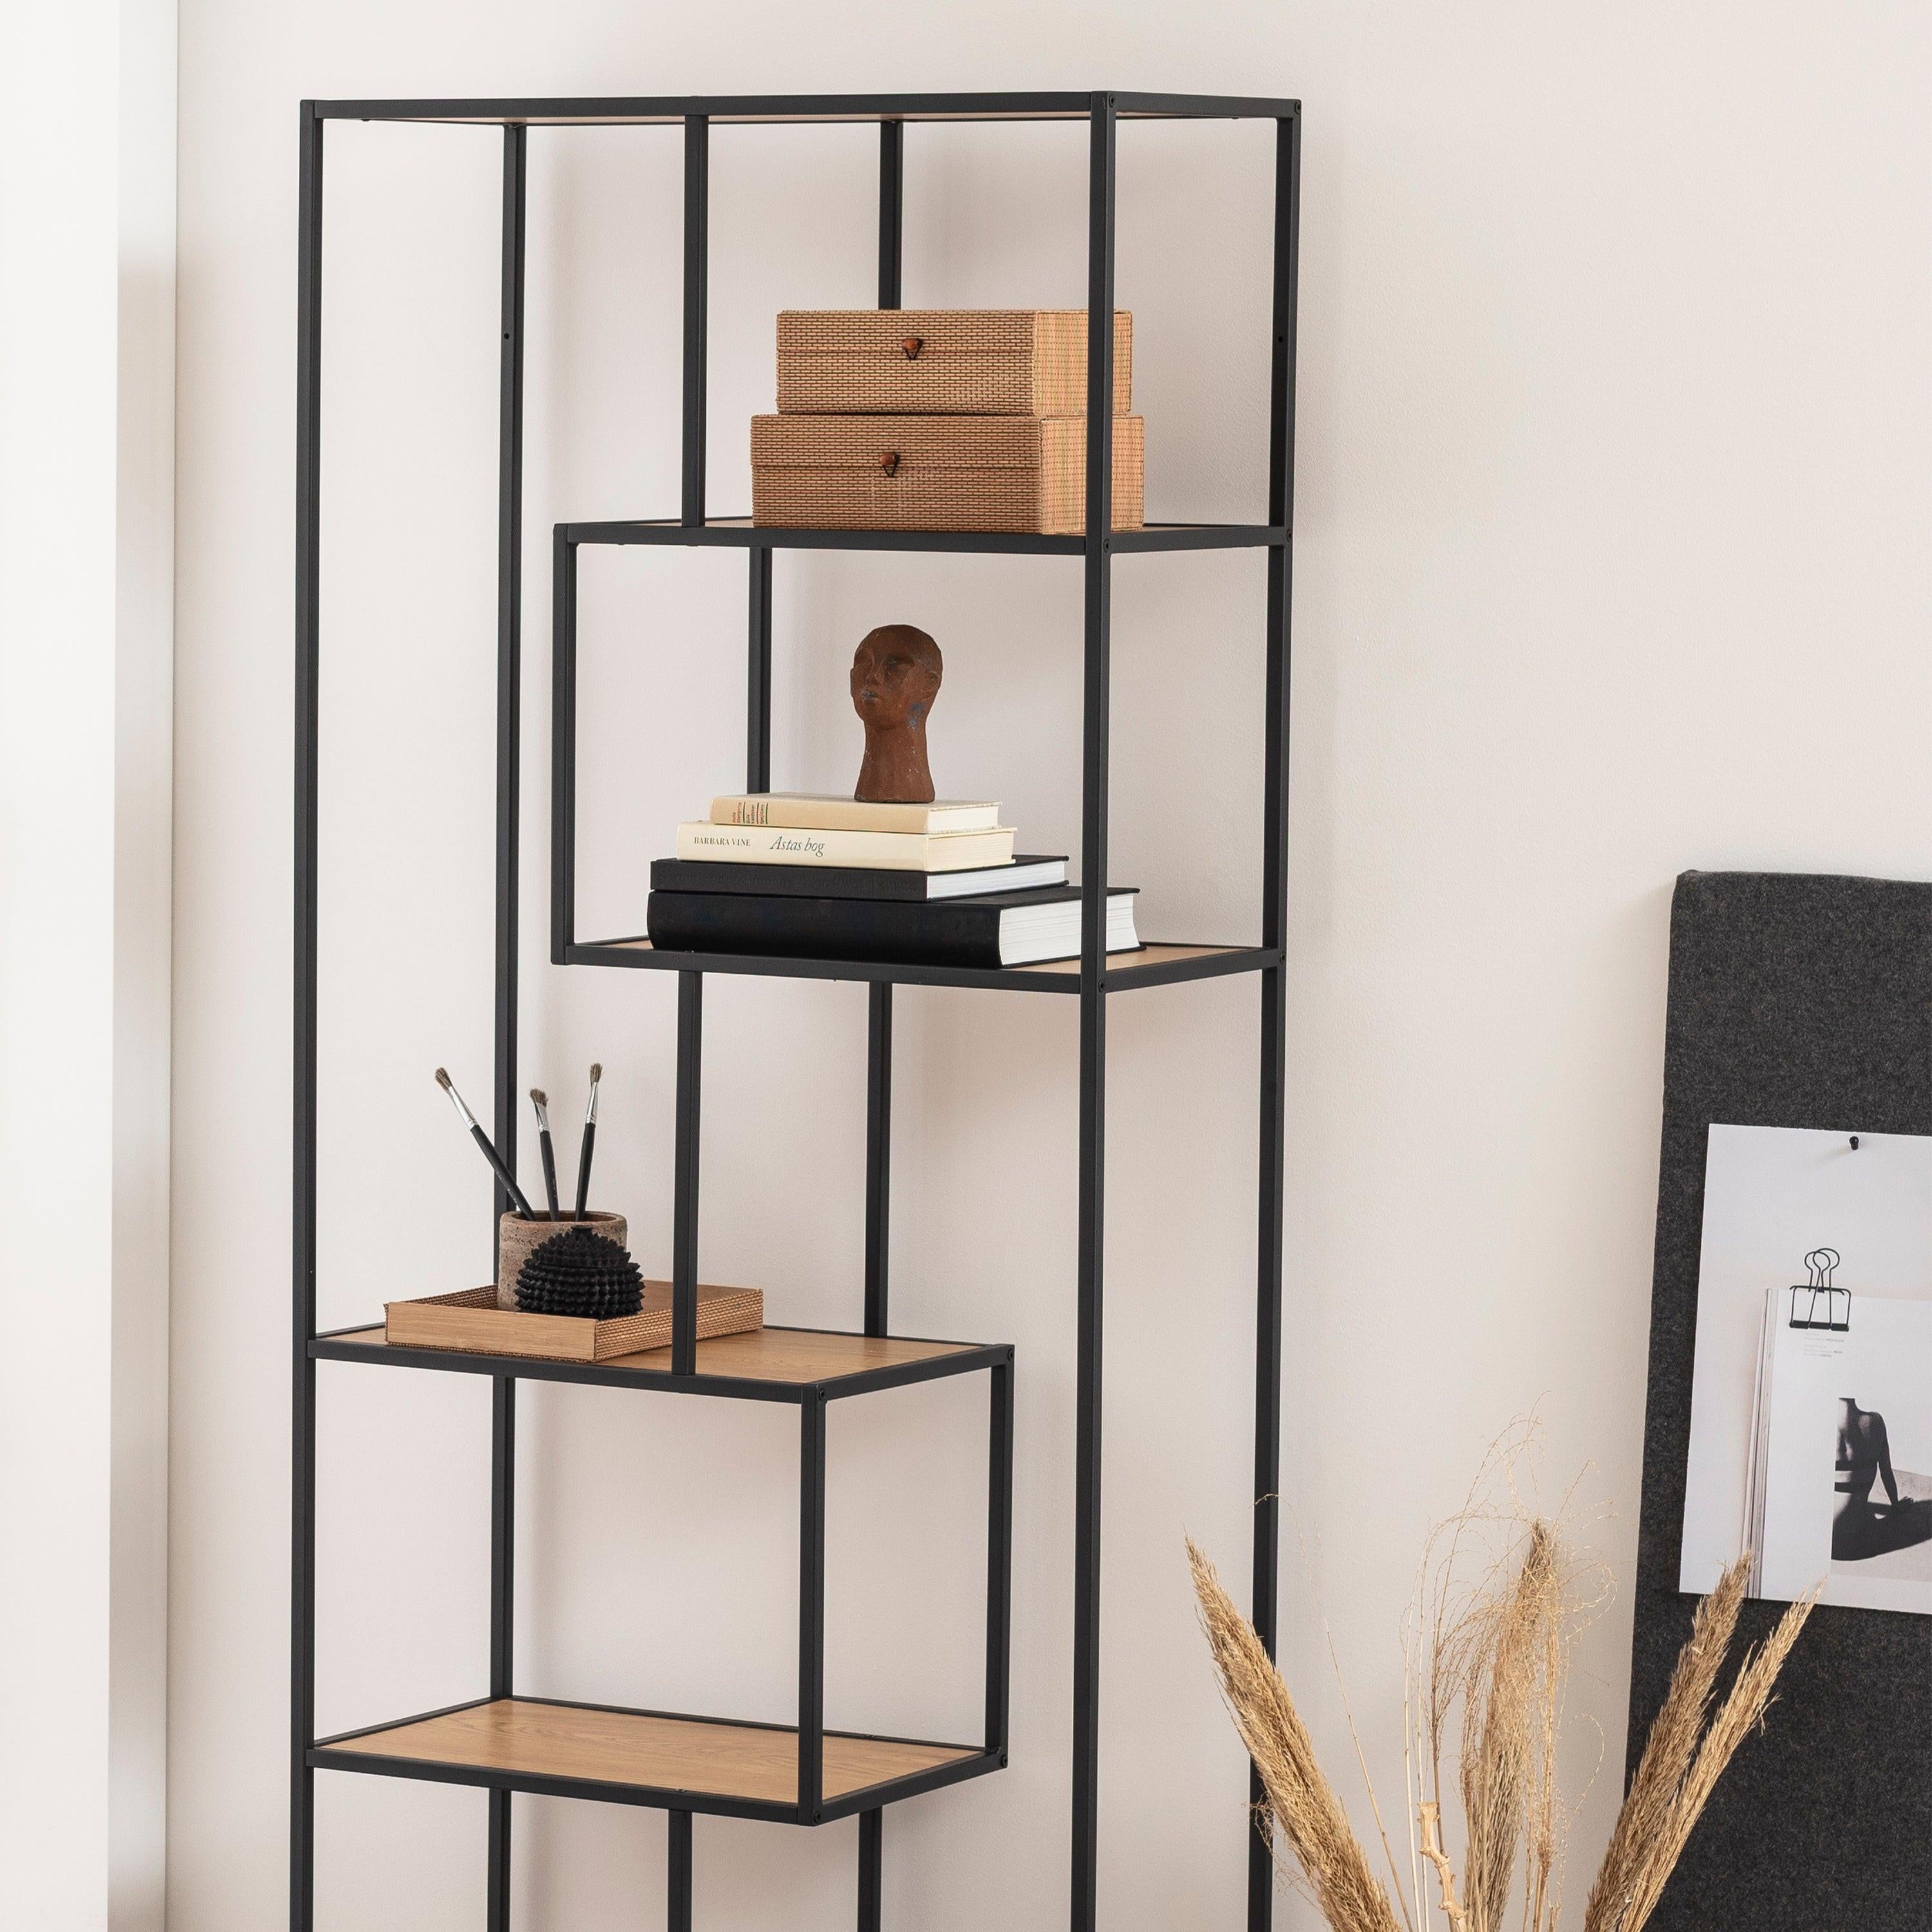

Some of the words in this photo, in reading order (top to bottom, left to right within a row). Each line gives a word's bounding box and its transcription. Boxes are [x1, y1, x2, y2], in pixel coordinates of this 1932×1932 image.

[694, 837, 730, 846] BARBARA
[732, 838, 751, 846] VINE
[770, 835, 802, 851] Astas
[804, 838, 826, 857] bog
